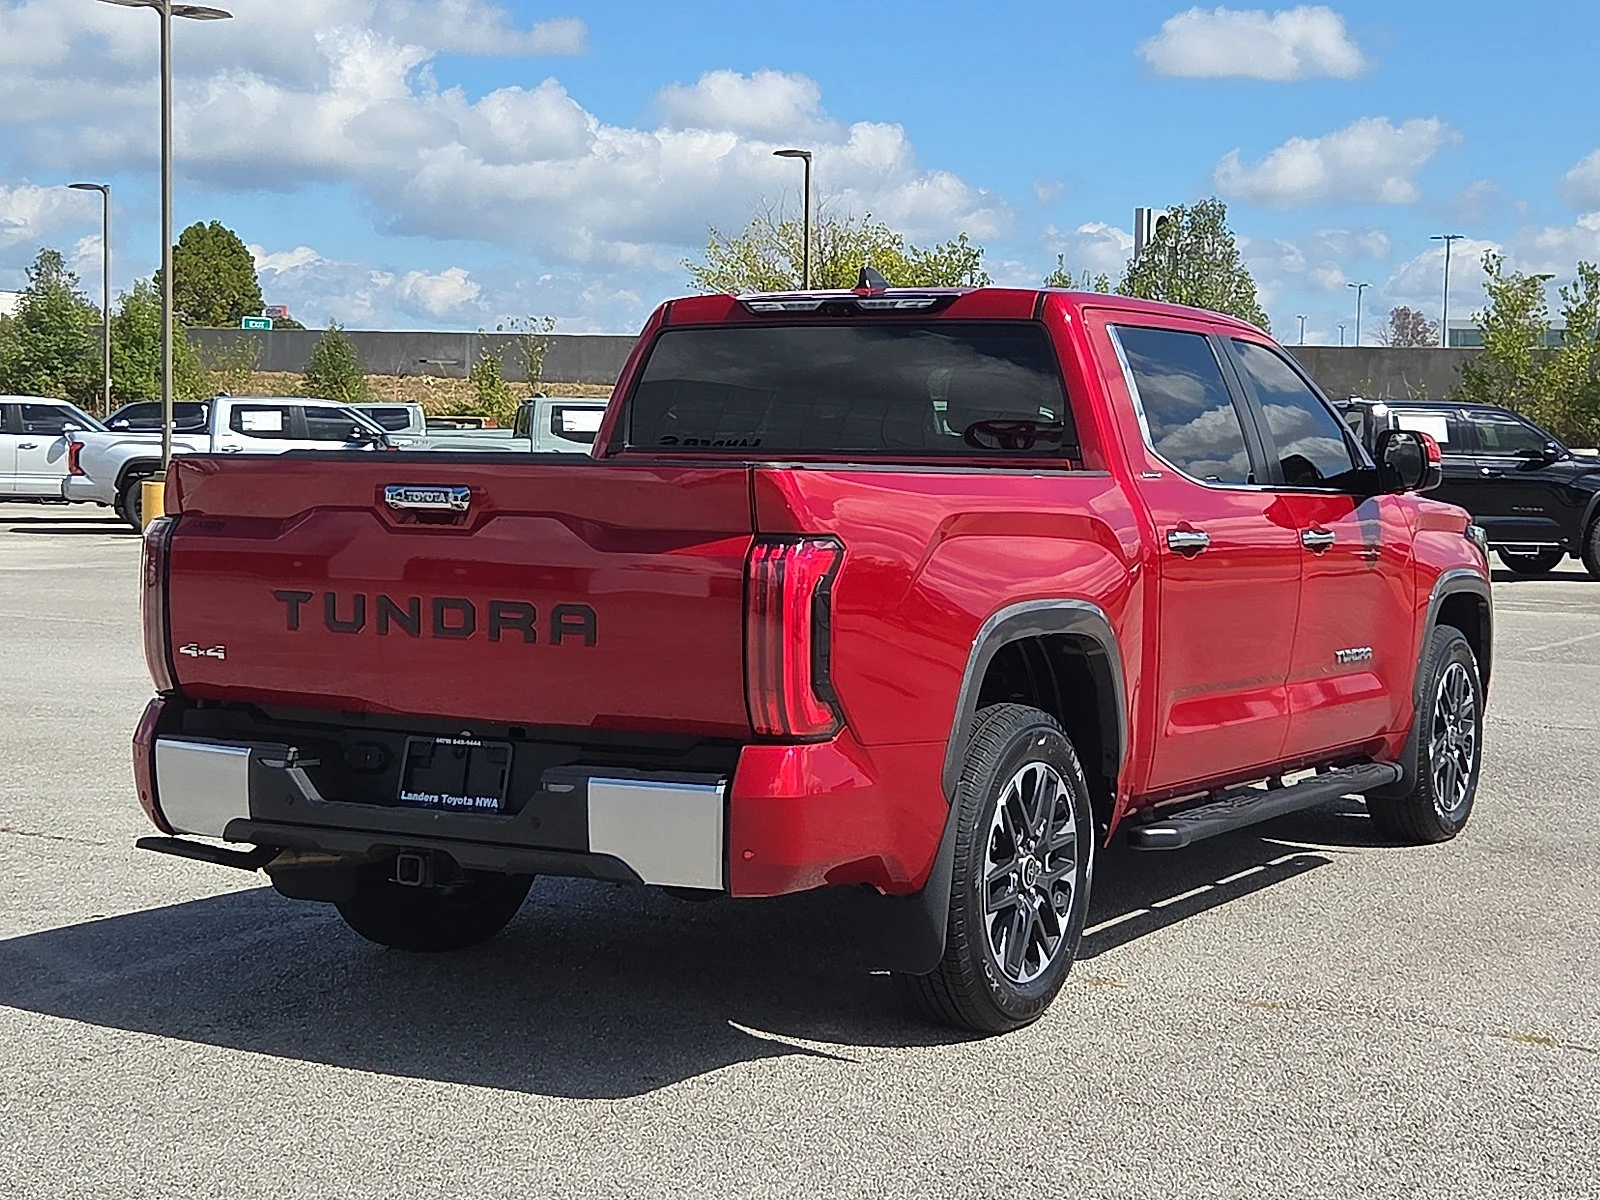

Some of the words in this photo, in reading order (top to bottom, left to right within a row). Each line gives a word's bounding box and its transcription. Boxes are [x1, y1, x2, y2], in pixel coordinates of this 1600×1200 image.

[406, 491, 446, 503] TOYOTA
[273, 589, 597, 647] TUNDRA
[1335, 646, 1373, 664] TUNDRA
[400, 790, 439, 803] Landers
[441, 793, 474, 806] Toyota
[475, 796, 499, 808] NWA
